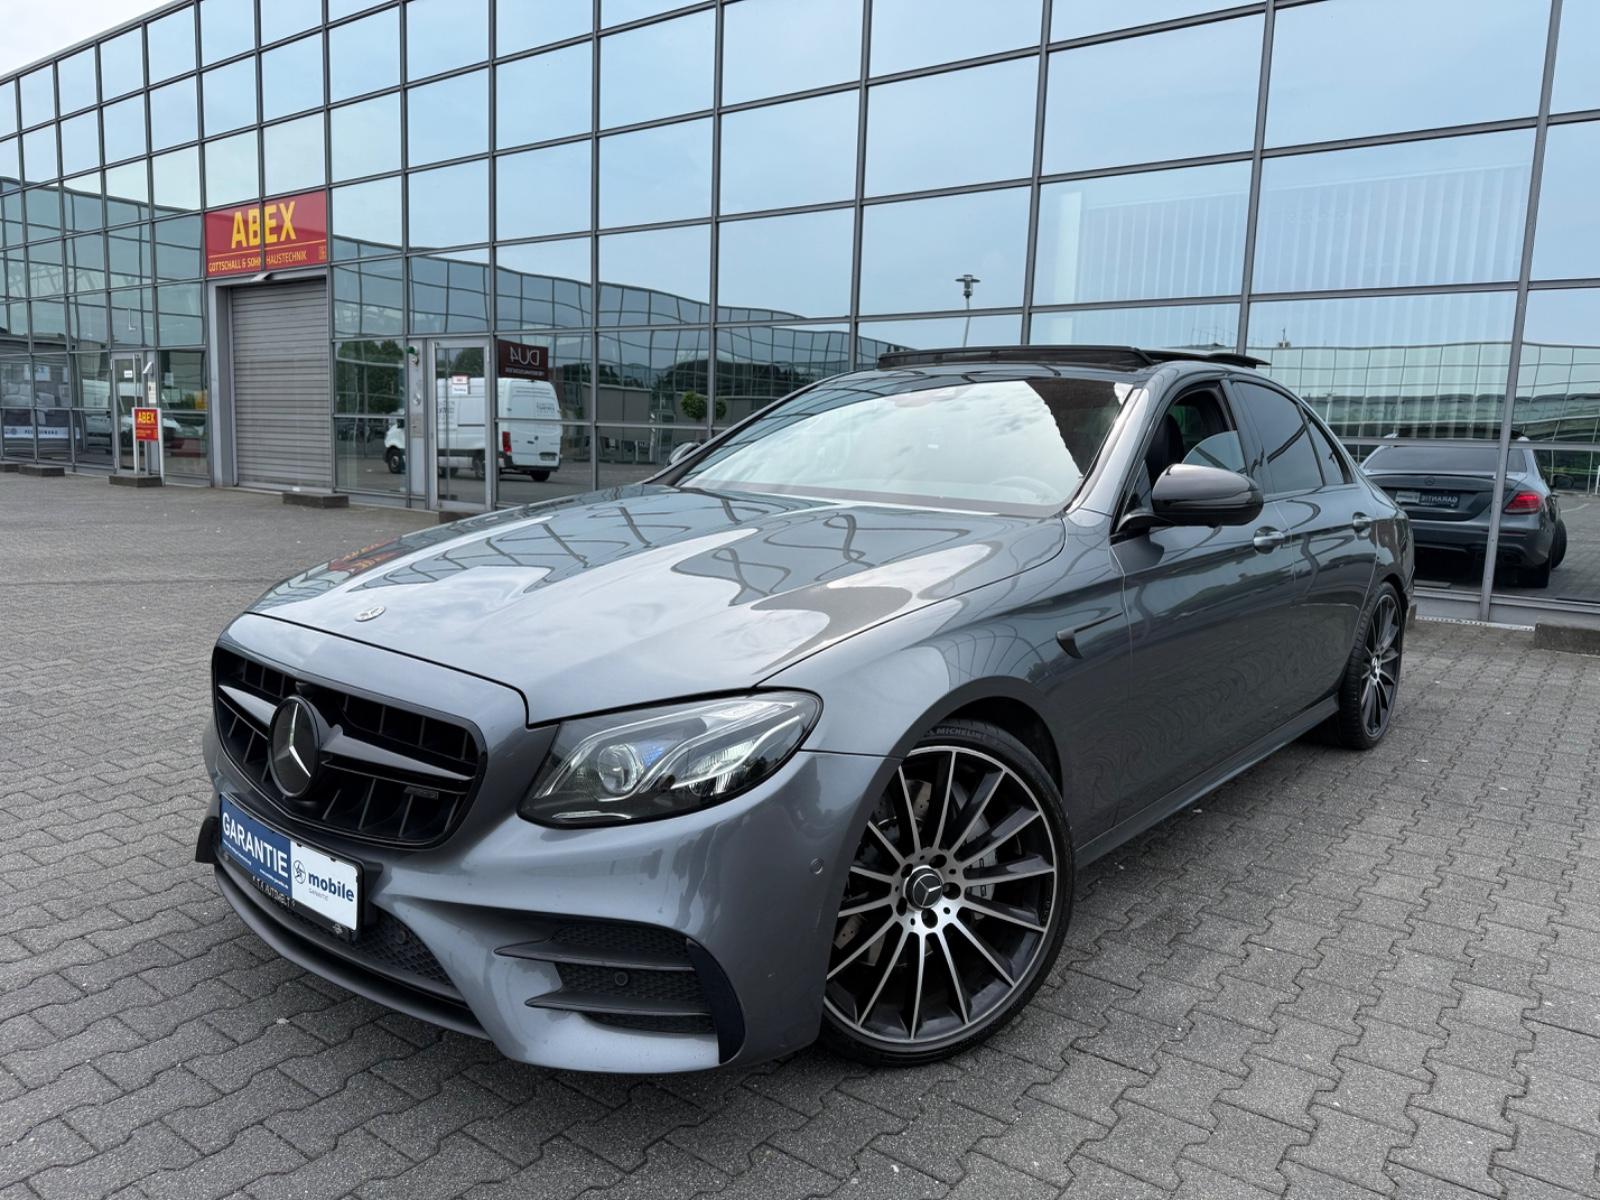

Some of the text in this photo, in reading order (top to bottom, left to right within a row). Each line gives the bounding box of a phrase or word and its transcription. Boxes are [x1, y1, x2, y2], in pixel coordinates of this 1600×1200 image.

[231, 201, 297, 249] ABEX
[208, 261, 241, 272] GOTTSCHALL
[266, 250, 307, 264] HAUSTECHNIK
[138, 411, 156, 424] ABEX
[222, 812, 289, 878] GARANTIE
[308, 871, 355, 903] mobile
